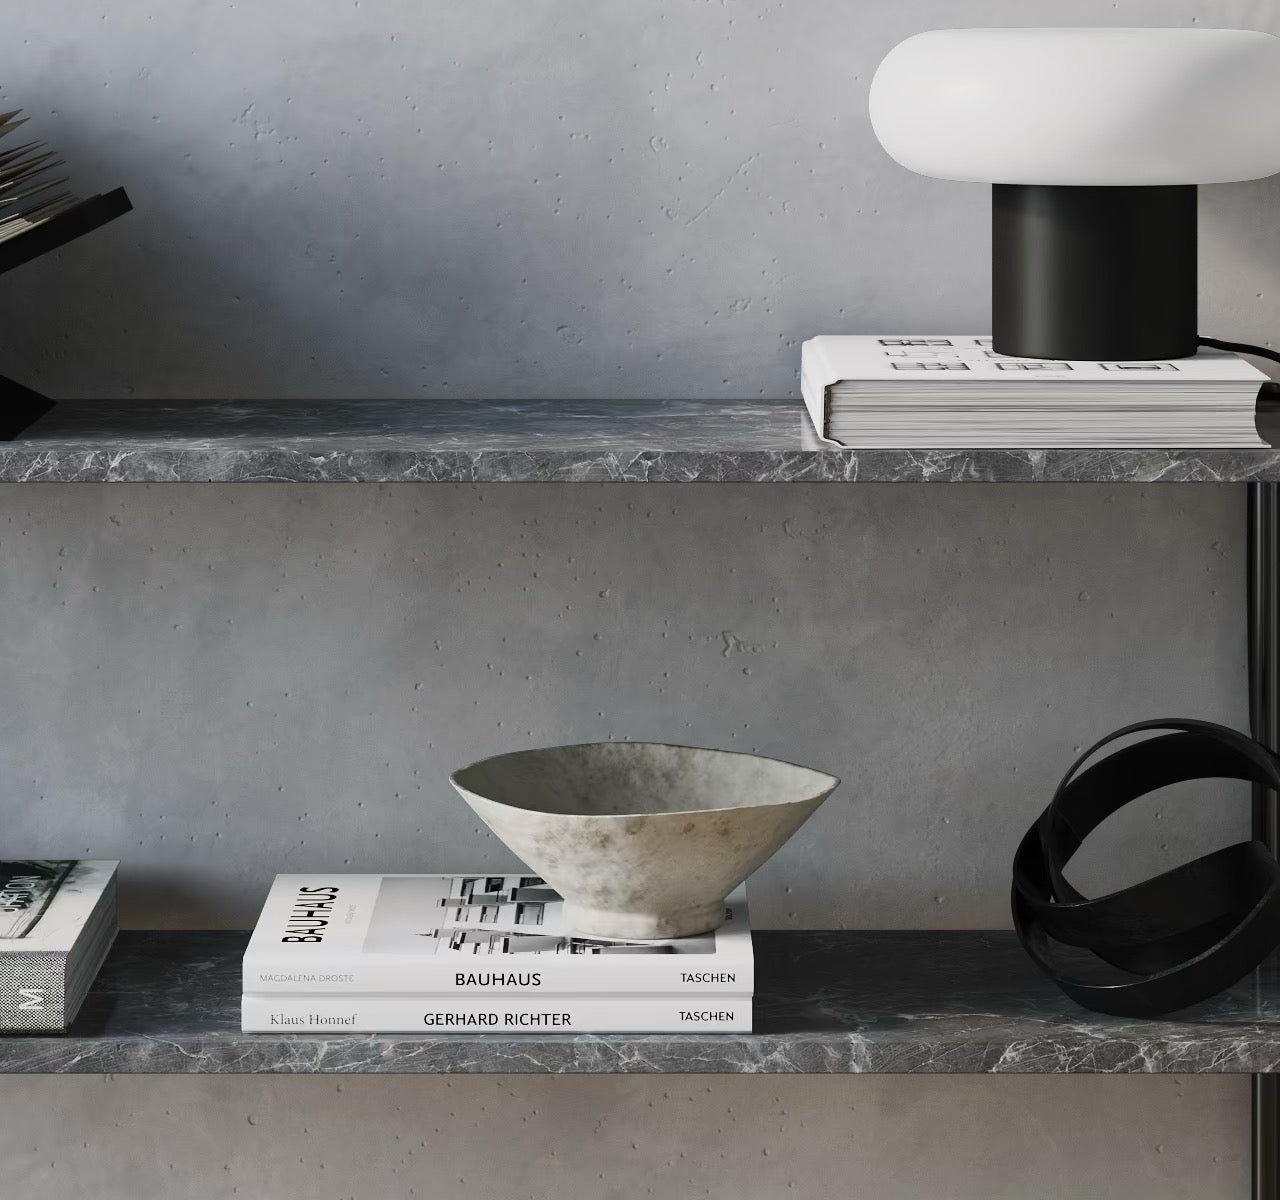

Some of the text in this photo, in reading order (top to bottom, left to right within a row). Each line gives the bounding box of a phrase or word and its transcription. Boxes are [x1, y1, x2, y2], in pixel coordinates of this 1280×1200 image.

[281, 886, 340, 943] BAUHAUS
[259, 974, 354, 983] MAGDALENA DROSTE
[455, 972, 542, 987] BAUHAUS
[680, 972, 736, 983] TASCHEN
[269, 1013, 358, 1026] Klaus Honnef
[423, 1013, 572, 1026] GERHARD RICHTER
[679, 1011, 734, 1021] TASCHEN
